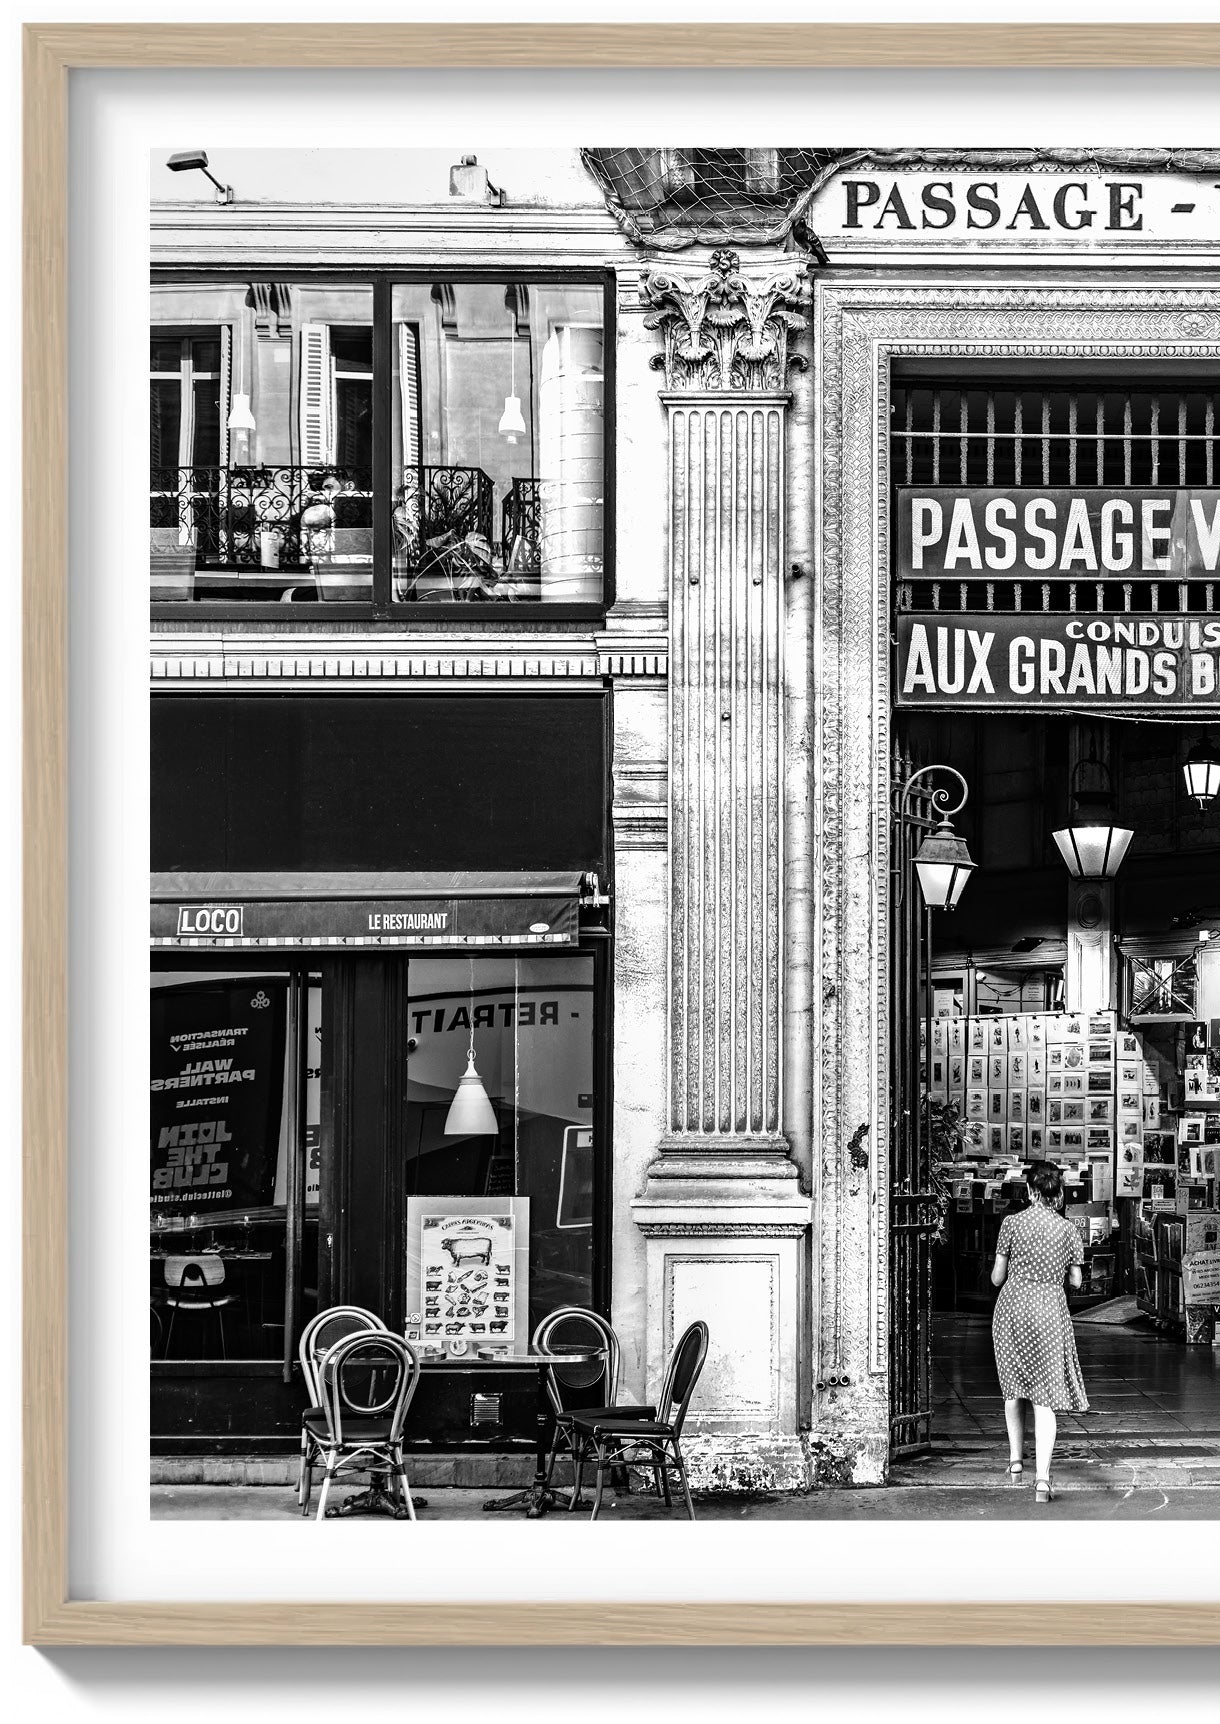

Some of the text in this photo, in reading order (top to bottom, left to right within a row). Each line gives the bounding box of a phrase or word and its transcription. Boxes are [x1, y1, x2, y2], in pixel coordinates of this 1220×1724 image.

[841, 181, 1145, 231] PASSAGE
[910, 497, 1173, 571] PASSAGE
[902, 623, 996, 696] AUX
[1008, 632, 1178, 696] GRANDS
[181, 907, 240, 934] LOCO
[368, 912, 447, 930] LE RESTAURANT
